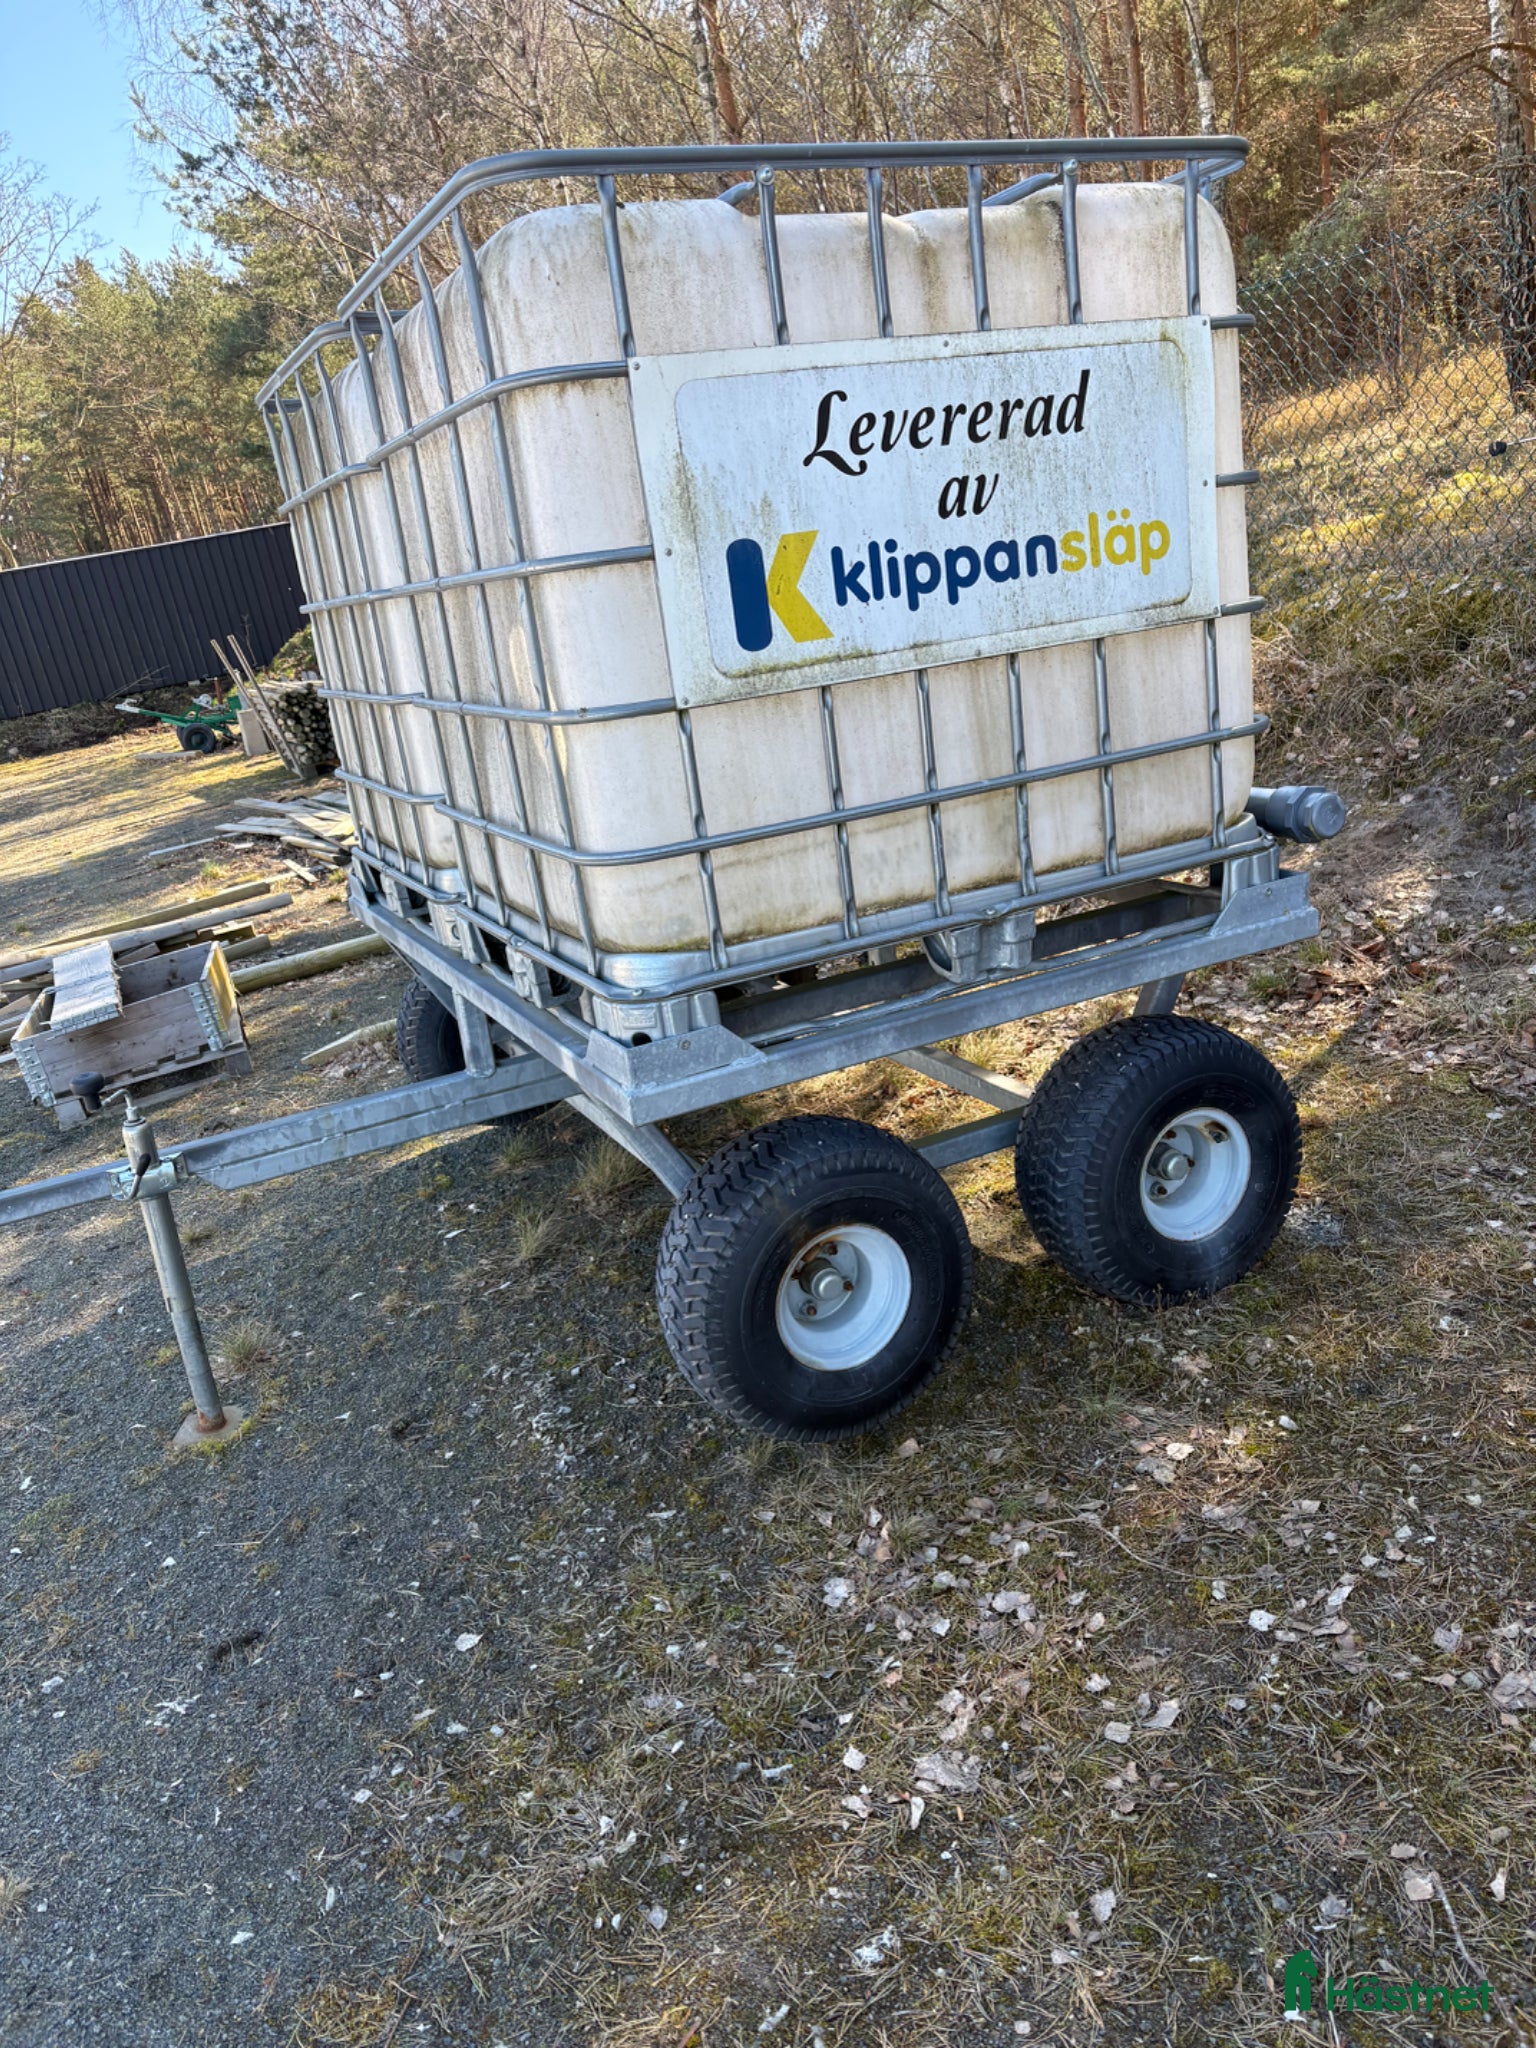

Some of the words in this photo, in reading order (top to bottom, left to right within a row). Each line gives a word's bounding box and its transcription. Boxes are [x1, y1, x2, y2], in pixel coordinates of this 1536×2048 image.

[803, 369, 1091, 476] Levererad
[938, 474, 998, 519] av
[832, 509, 1171, 611] klippansläp
